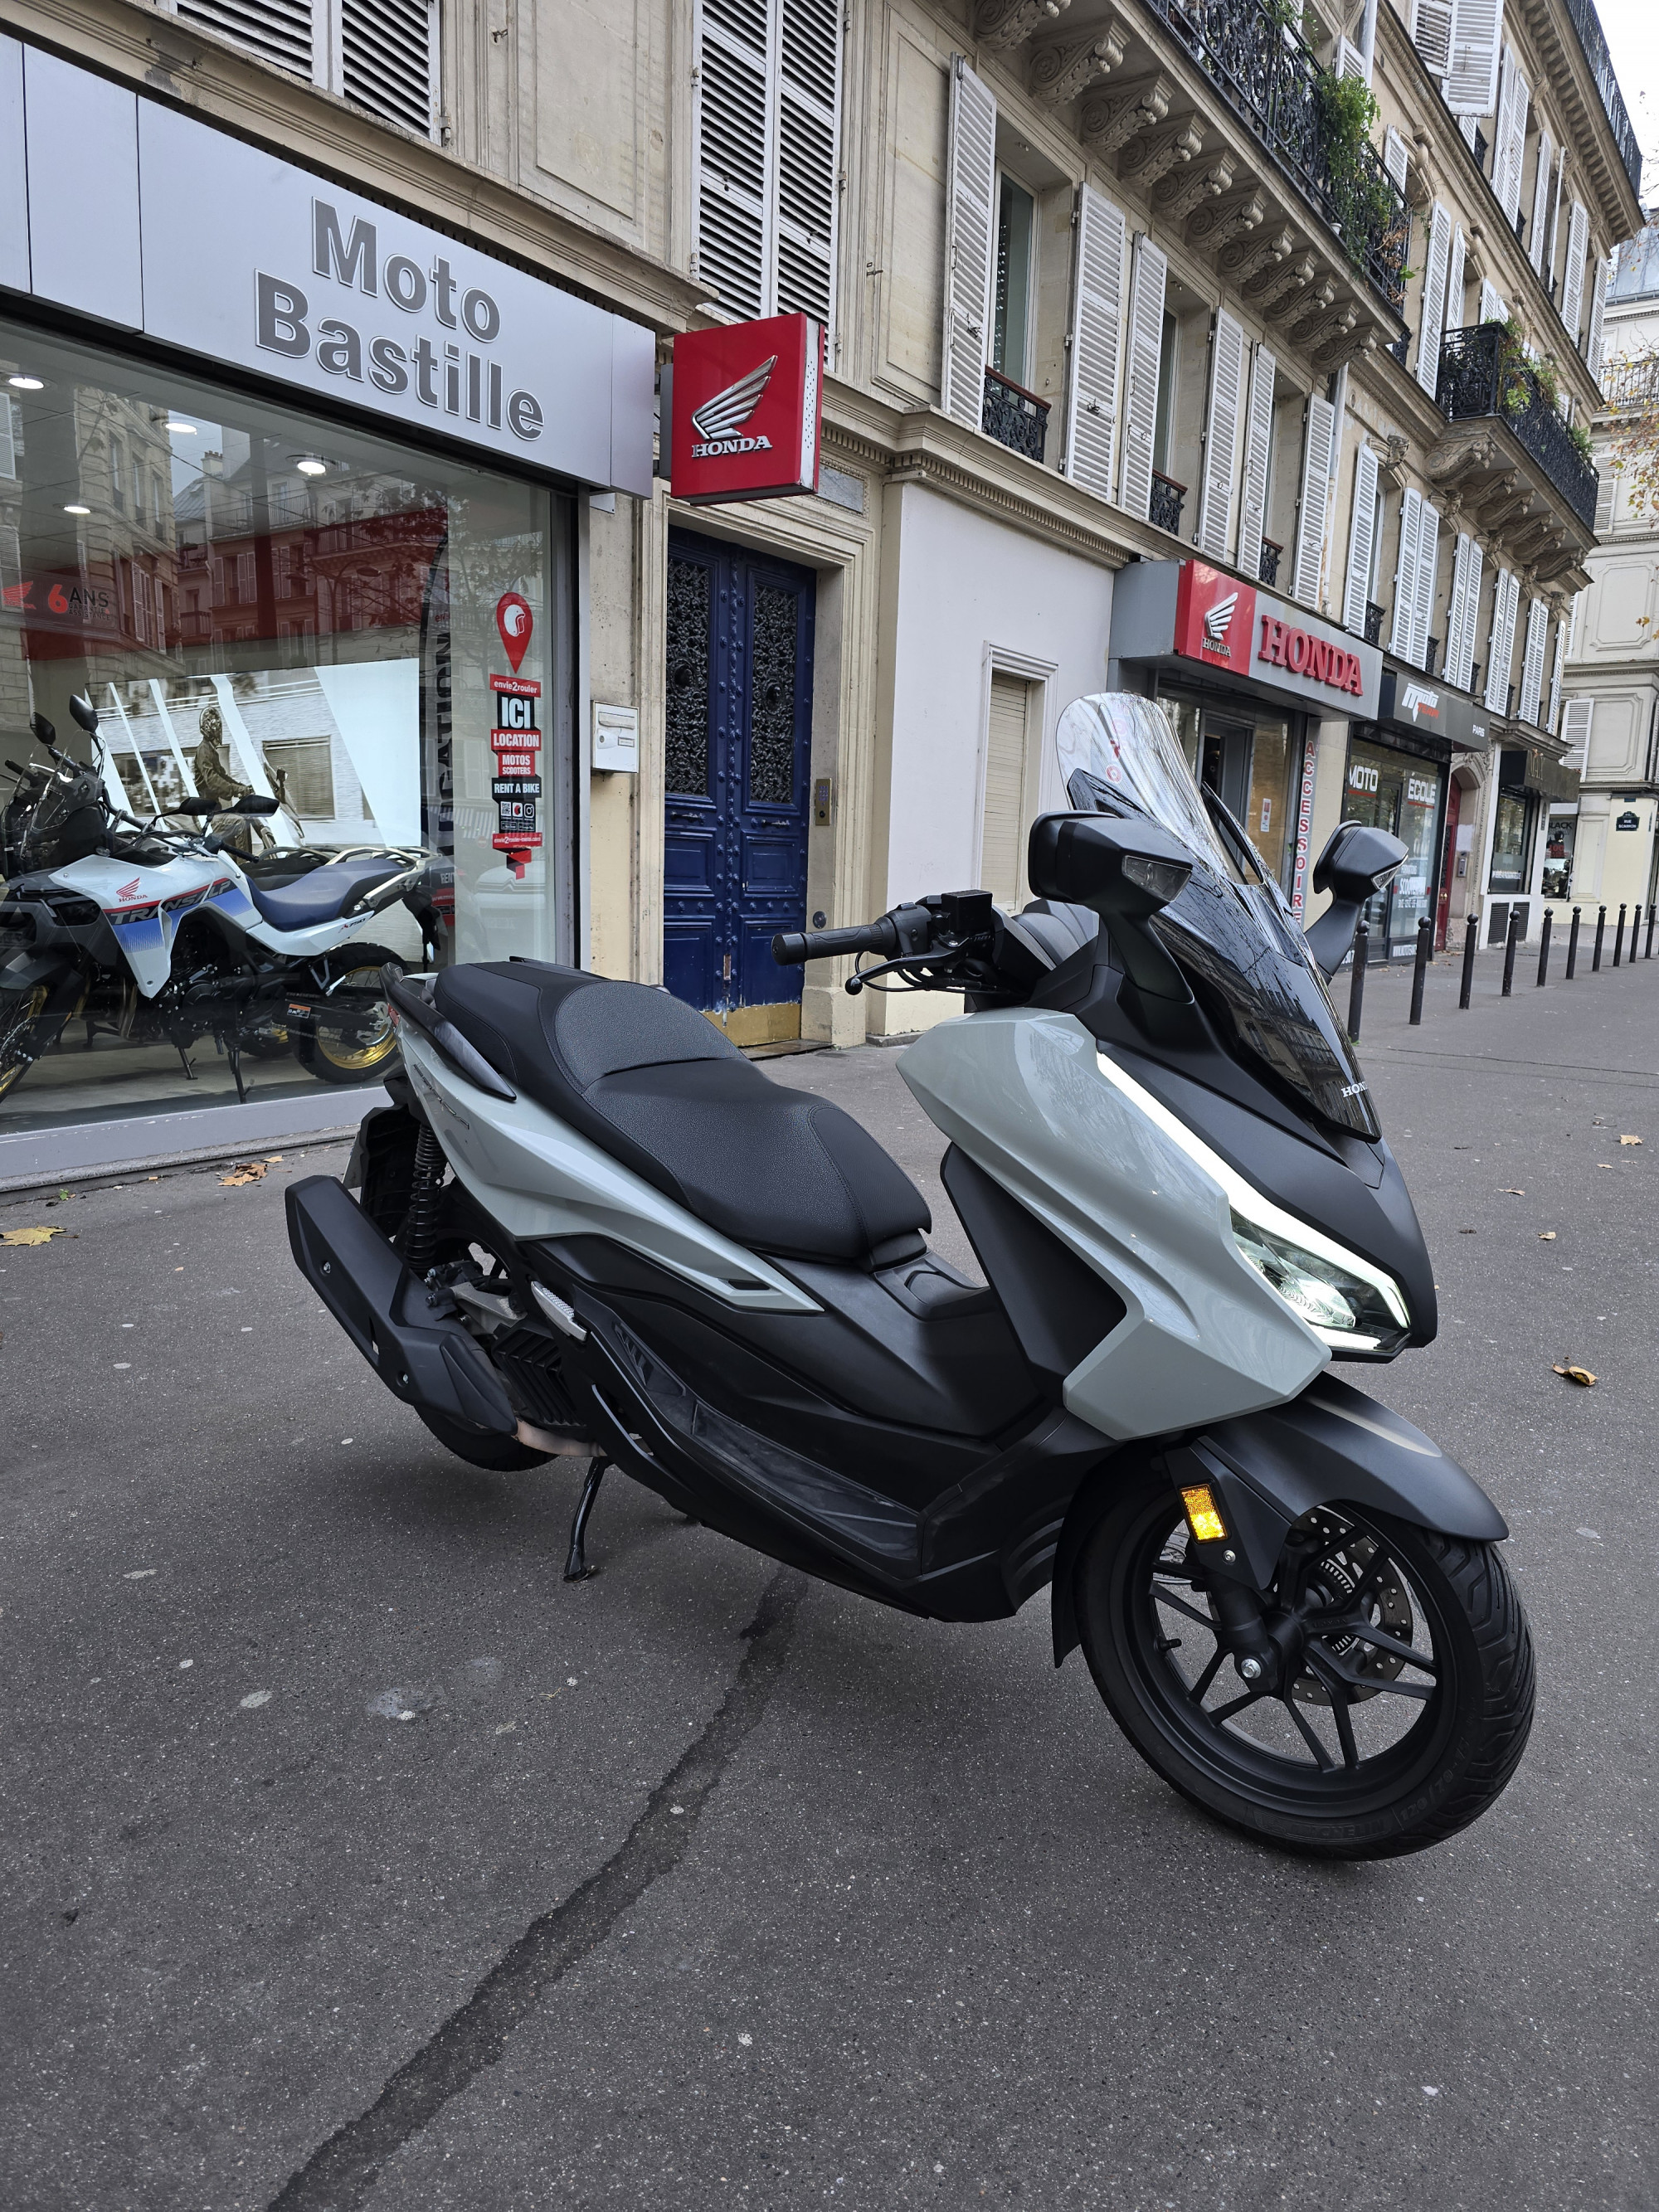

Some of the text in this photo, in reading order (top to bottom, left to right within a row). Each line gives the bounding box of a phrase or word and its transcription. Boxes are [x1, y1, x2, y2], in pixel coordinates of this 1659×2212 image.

[311, 196, 503, 343] Moto
[254, 268, 546, 441] Bastille
[691, 435, 773, 459] HONDA
[48, 584, 109, 614] 6 ANS
[1202, 638, 1231, 658] HONDA
[1258, 615, 1363, 697] HONDA
[494, 681, 538, 693] envie2rouler
[501, 697, 531, 729] ICI
[494, 733, 539, 746] LOCATION
[1472, 724, 1485, 737] PARIS
[502, 755, 530, 766] MOTOS
[494, 783, 539, 793] RENT A BIKE
[1349, 765, 1436, 805] MOTO ÉCOLE
[119, 894, 148, 902] HONDA
